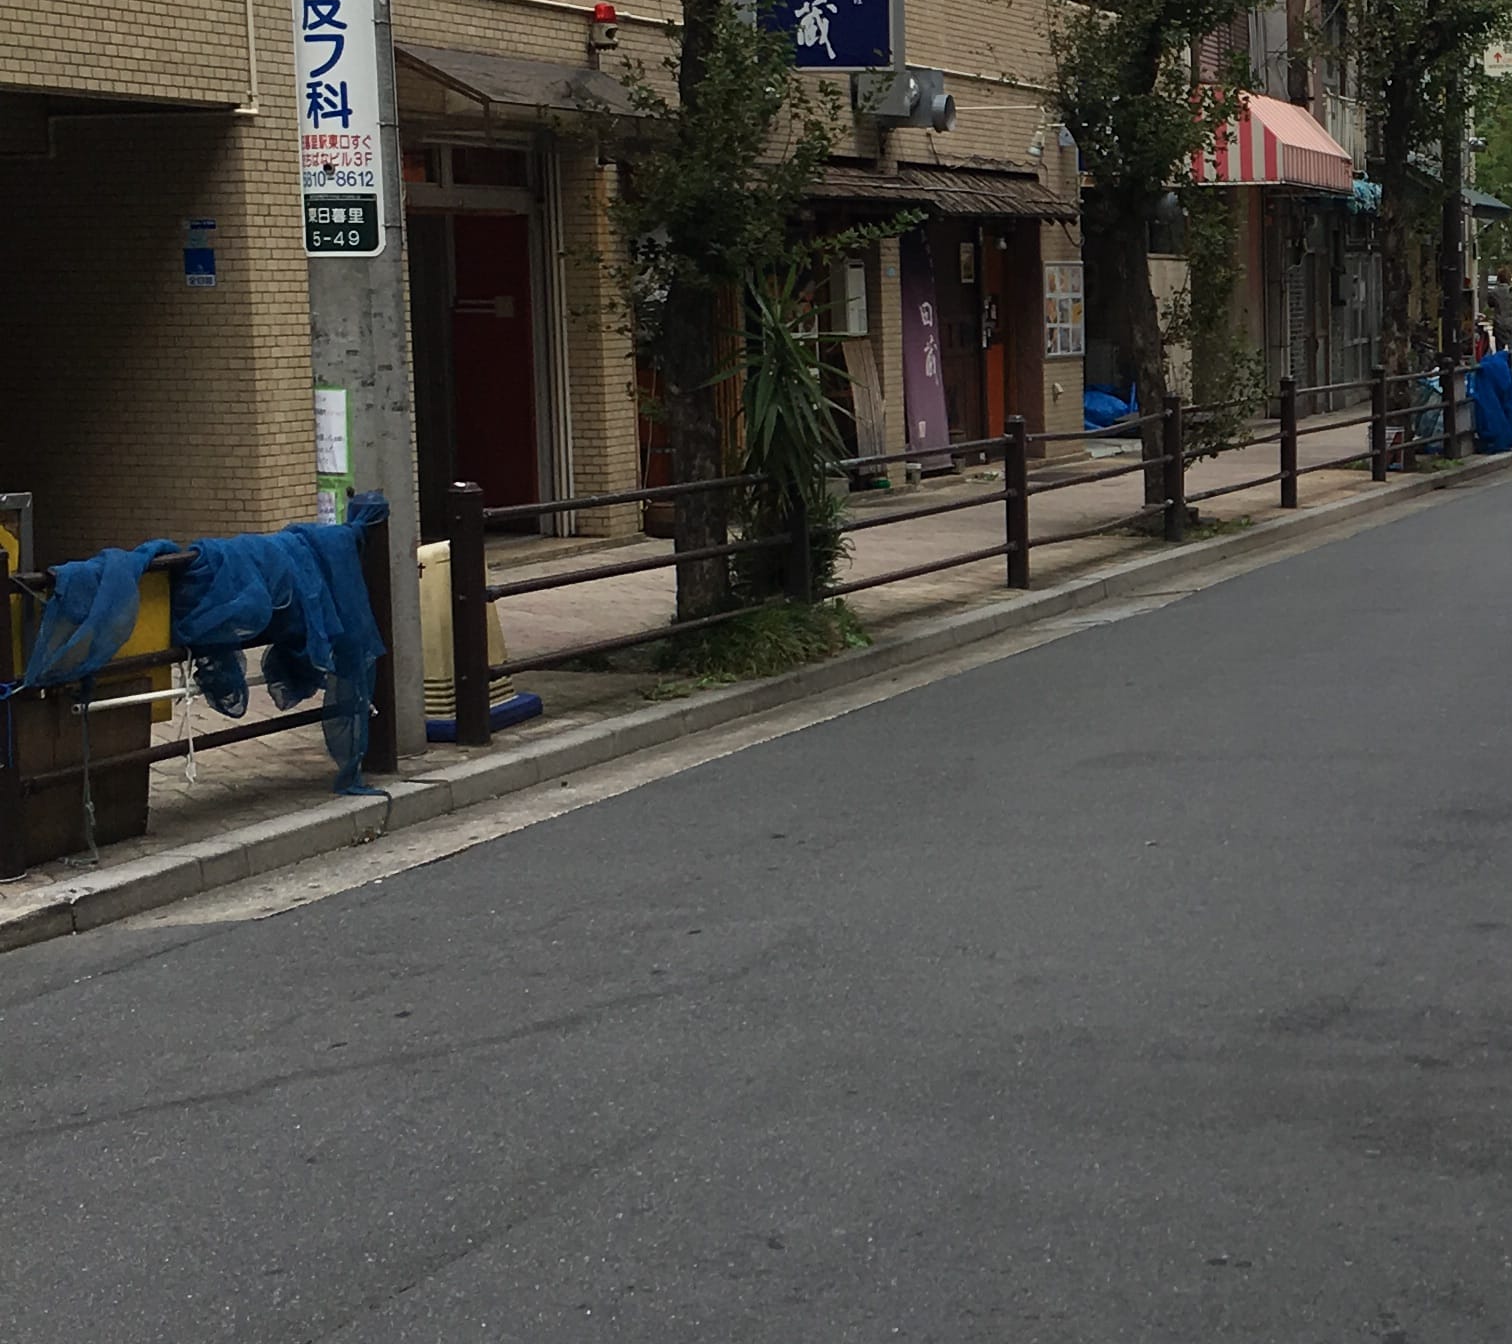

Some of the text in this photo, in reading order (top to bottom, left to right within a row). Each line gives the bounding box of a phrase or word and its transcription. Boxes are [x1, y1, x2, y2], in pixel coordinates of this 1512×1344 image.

[308, 207, 365, 224] 東日暮里
[313, 229, 360, 247] 5-49
